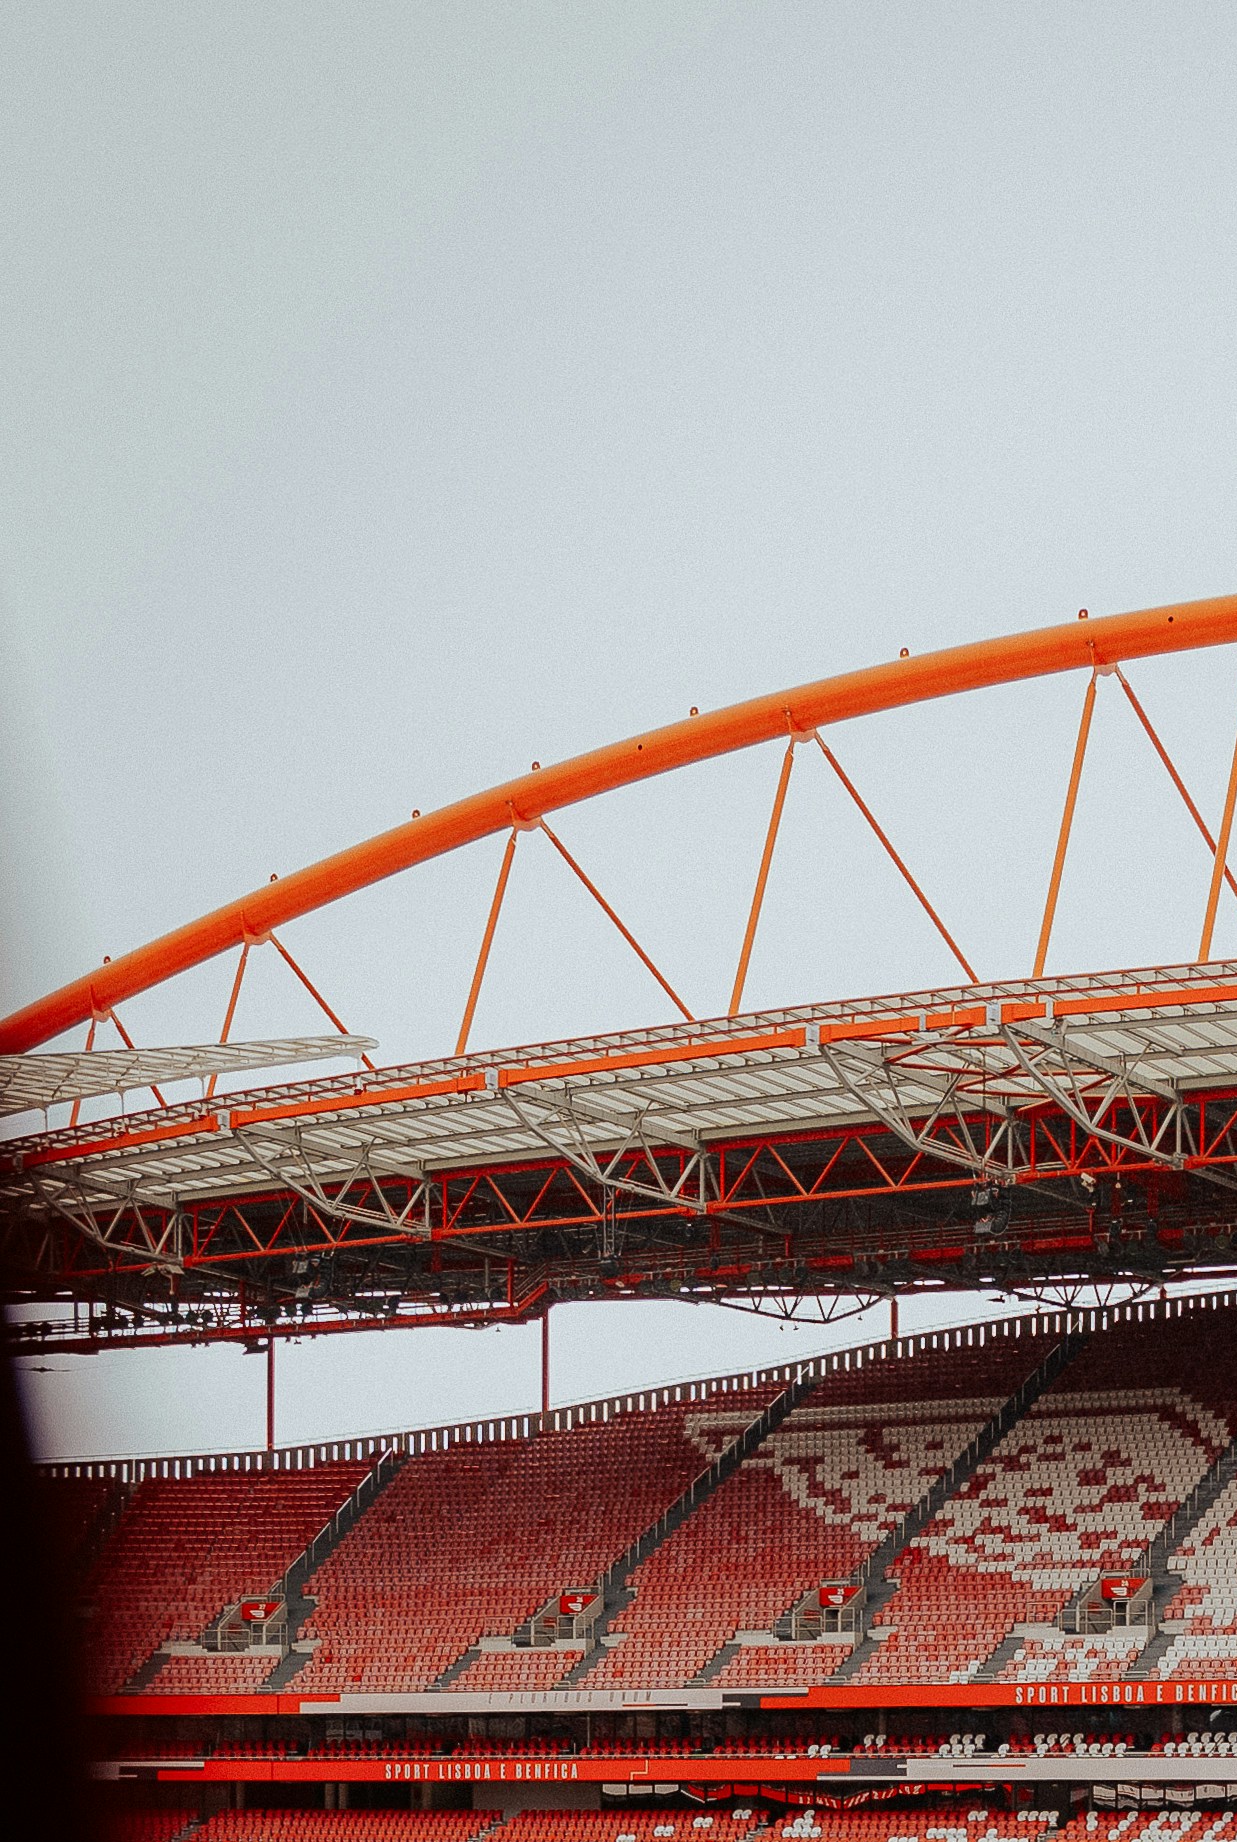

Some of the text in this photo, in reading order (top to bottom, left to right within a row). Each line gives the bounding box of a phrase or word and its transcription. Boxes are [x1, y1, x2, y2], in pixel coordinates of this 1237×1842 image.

[1015, 1686, 1069, 1704] SPORT
[1081, 1685, 1145, 1703] LISBOA
[1156, 1685, 1164, 1702] E
[385, 1763, 578, 1779] SPORT LISBOA E BENFICA
